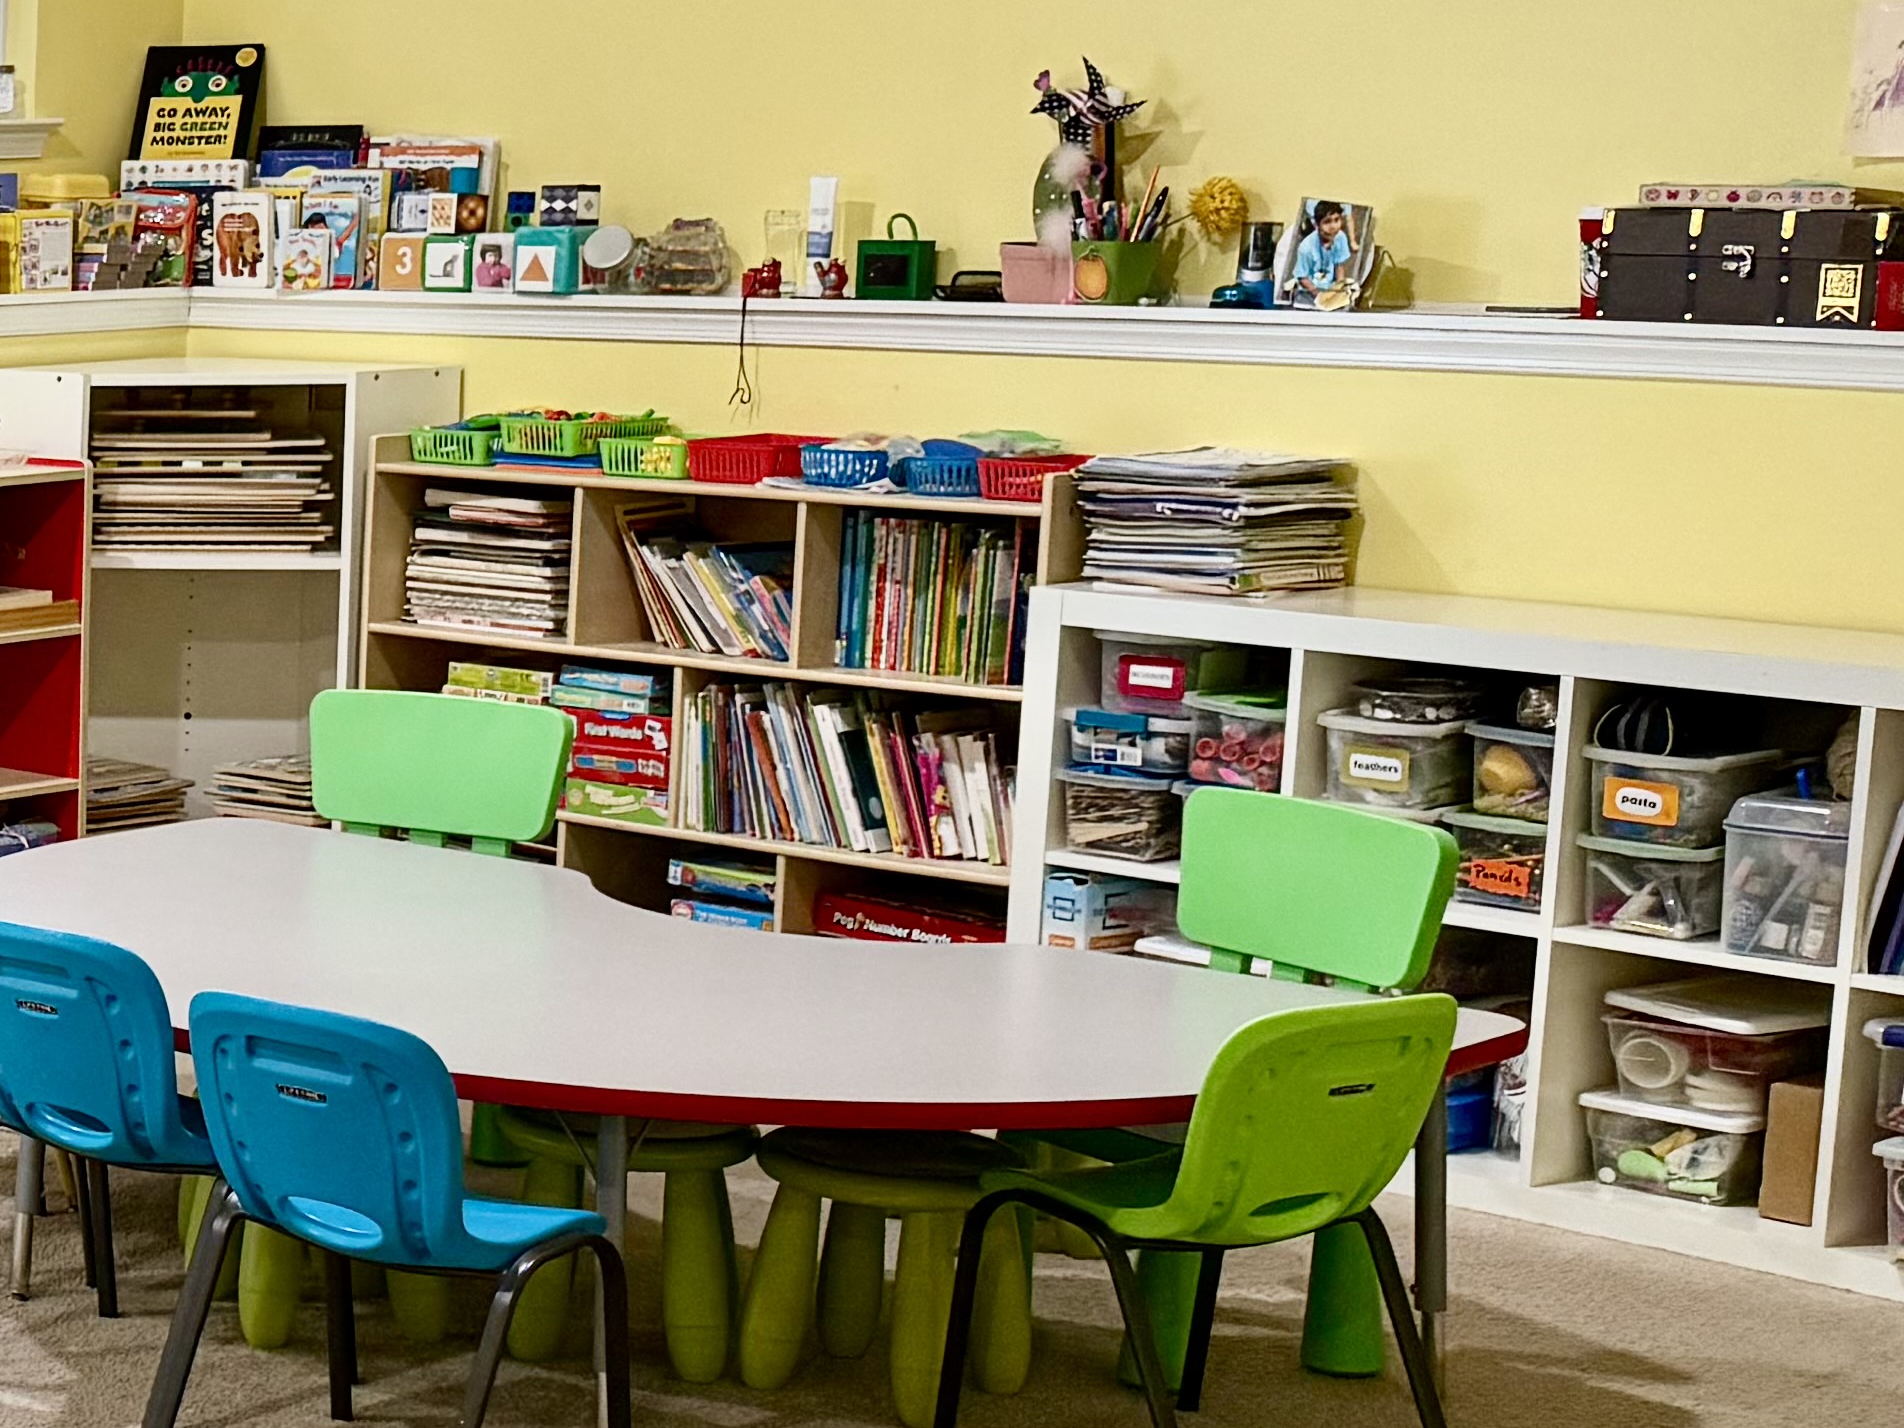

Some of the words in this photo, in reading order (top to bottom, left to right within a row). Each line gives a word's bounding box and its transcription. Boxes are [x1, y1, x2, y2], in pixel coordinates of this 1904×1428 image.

[156, 107, 178, 119] GO
[181, 106, 231, 119] AWAY,
[153, 122, 176, 133] BIG
[180, 121, 229, 132] GREEN
[150, 134, 228, 147] MONSTER!
[395, 246, 412, 276] 3
[1353, 760, 1400, 775] feathers
[1621, 794, 1657, 810] pasta
[832, 911, 854, 930] Peg
[863, 919, 908, 940] Number
